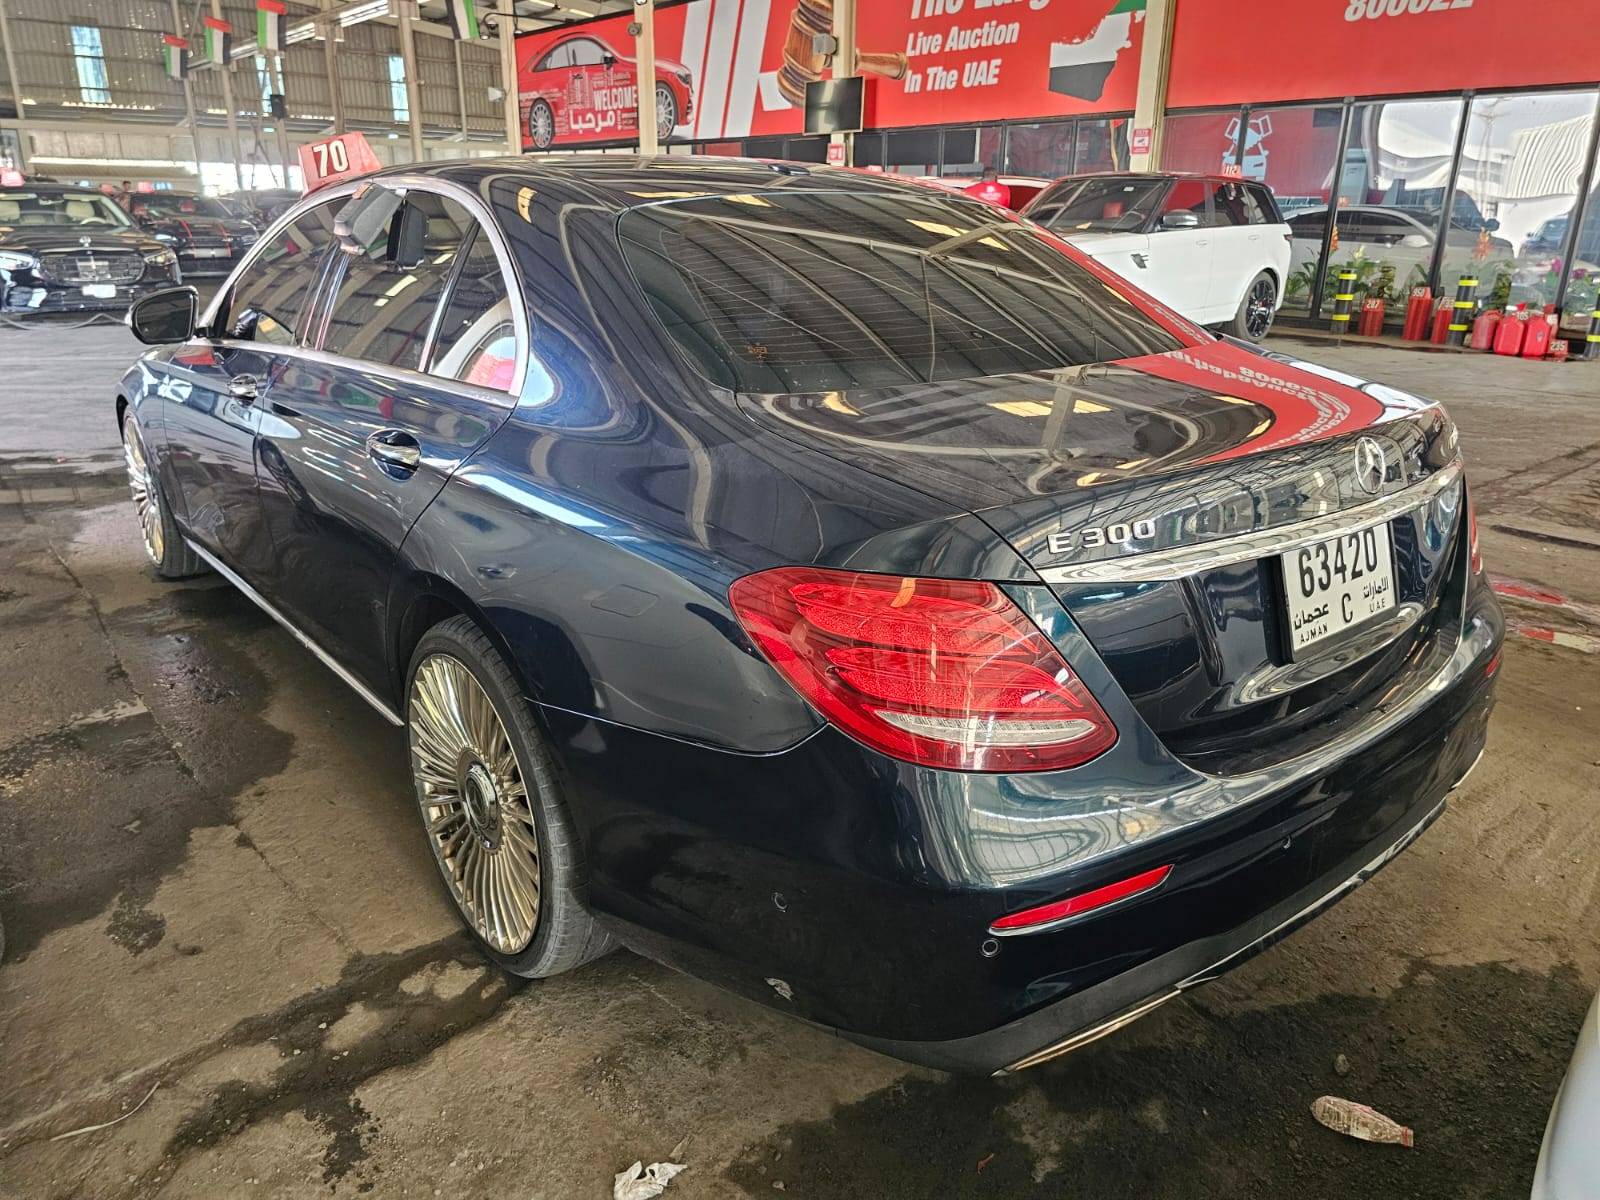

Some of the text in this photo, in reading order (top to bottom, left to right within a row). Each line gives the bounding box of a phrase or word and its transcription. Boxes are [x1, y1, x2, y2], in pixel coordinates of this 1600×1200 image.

[906, 20, 1020, 57] Live Auction
[904, 58, 1002, 94] In The UAE
[593, 86, 638, 111] WELCOME
[569, 110, 617, 134] مرحبا
[313, 140, 349, 178] 70
[1047, 519, 1156, 554] E 300
[1298, 526, 1378, 598] 63420
[1294, 603, 1329, 631] عجمان
[1342, 593, 1353, 623] C
[1369, 598, 1386, 613] UAE
[1300, 623, 1328, 644] AJMAN
